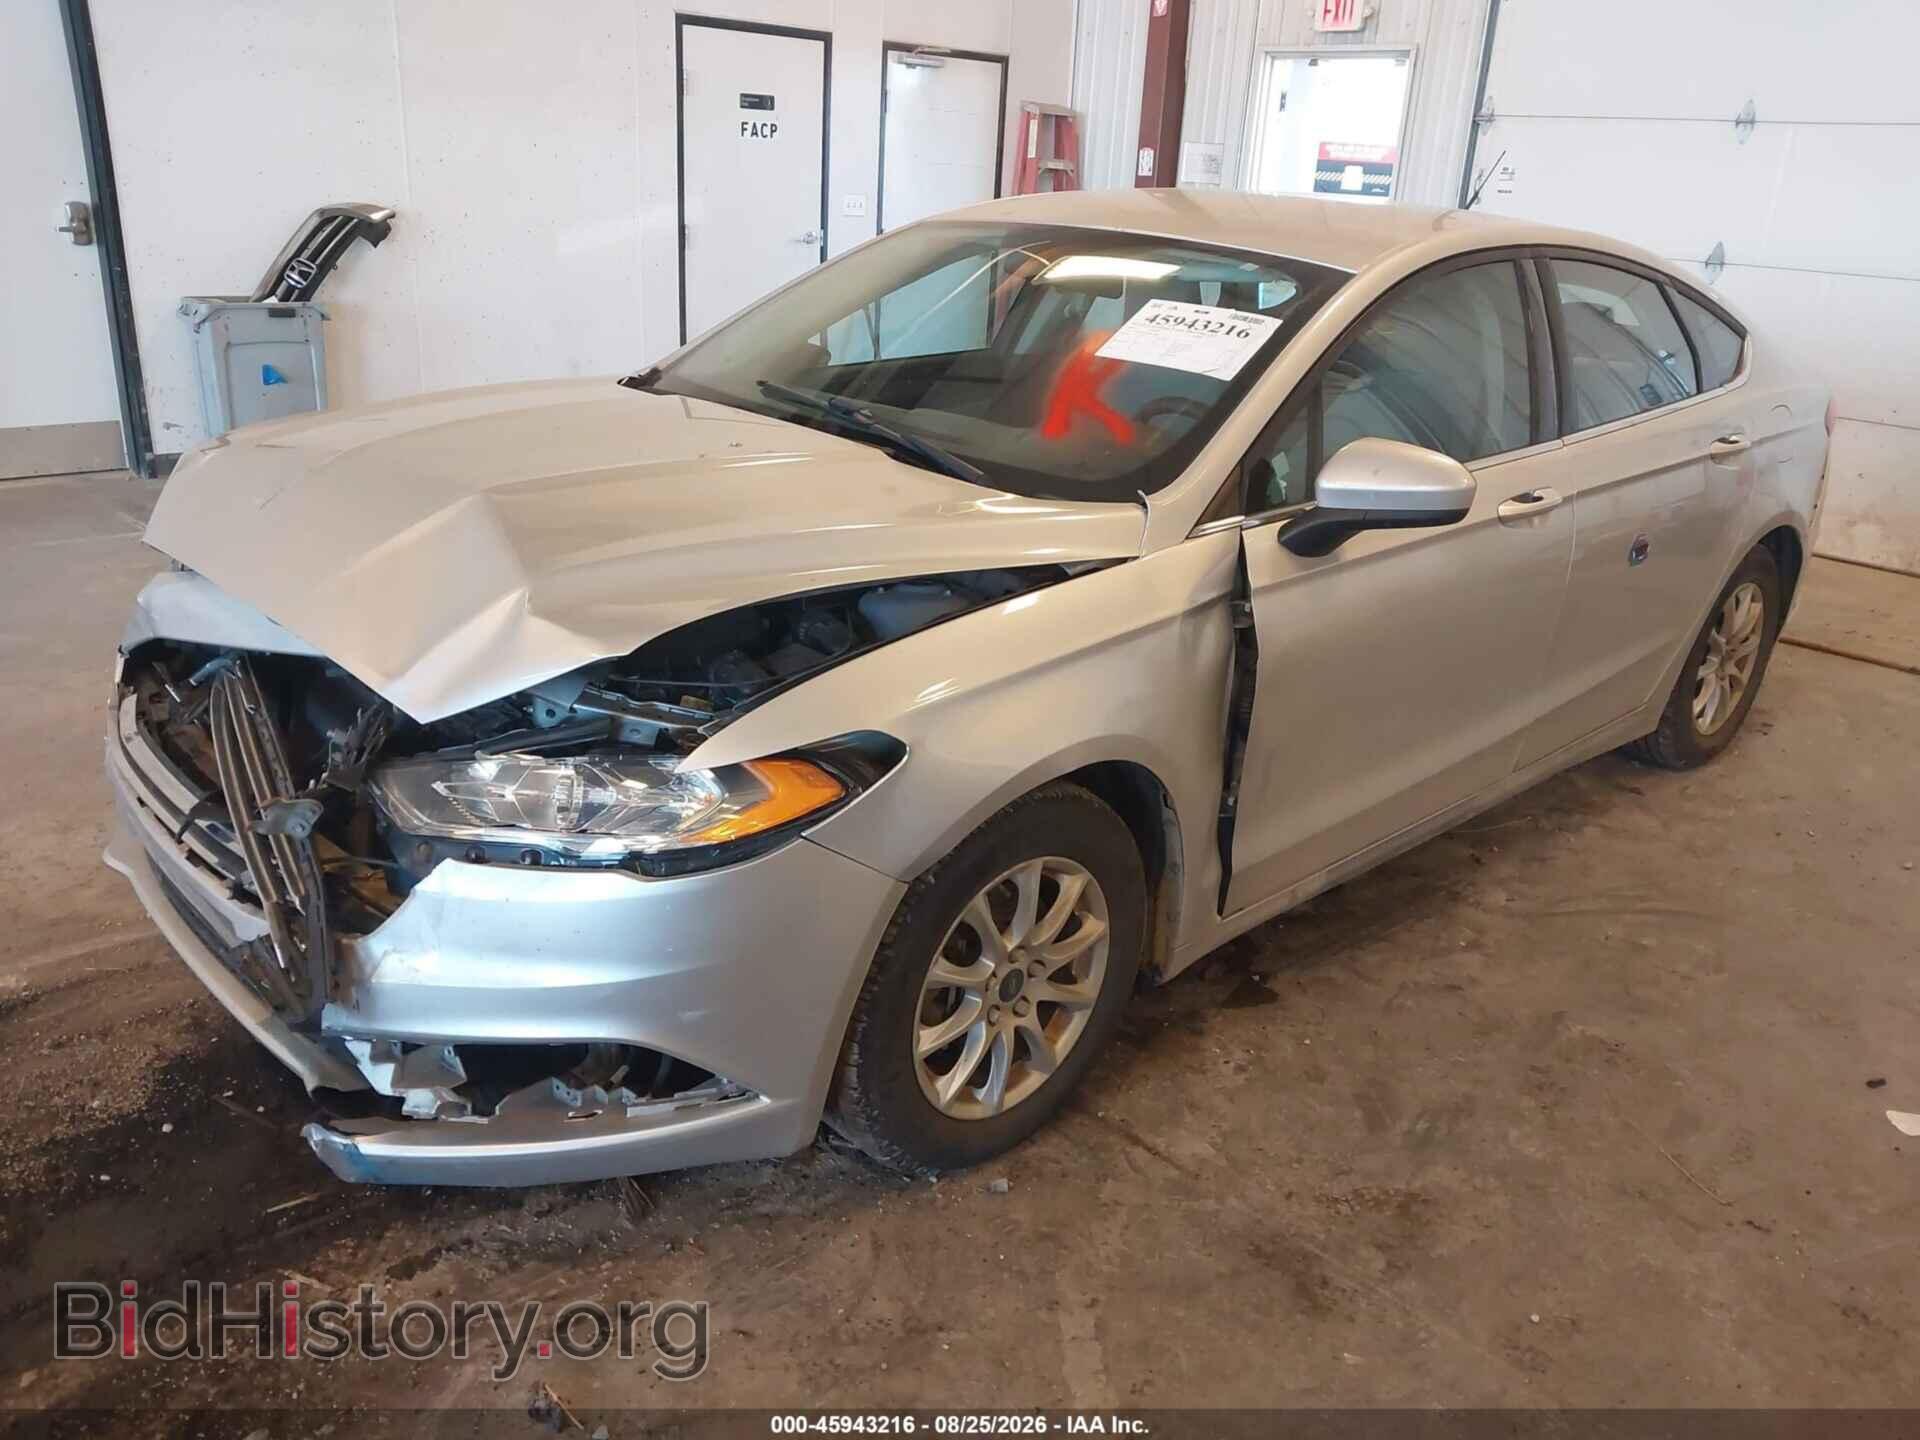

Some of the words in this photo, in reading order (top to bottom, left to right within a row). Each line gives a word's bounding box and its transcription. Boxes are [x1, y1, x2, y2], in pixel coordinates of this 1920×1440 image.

[741, 121, 778, 139] FACP
[1144, 312, 1251, 340] 45943216
[1043, 330, 1133, 446] K
